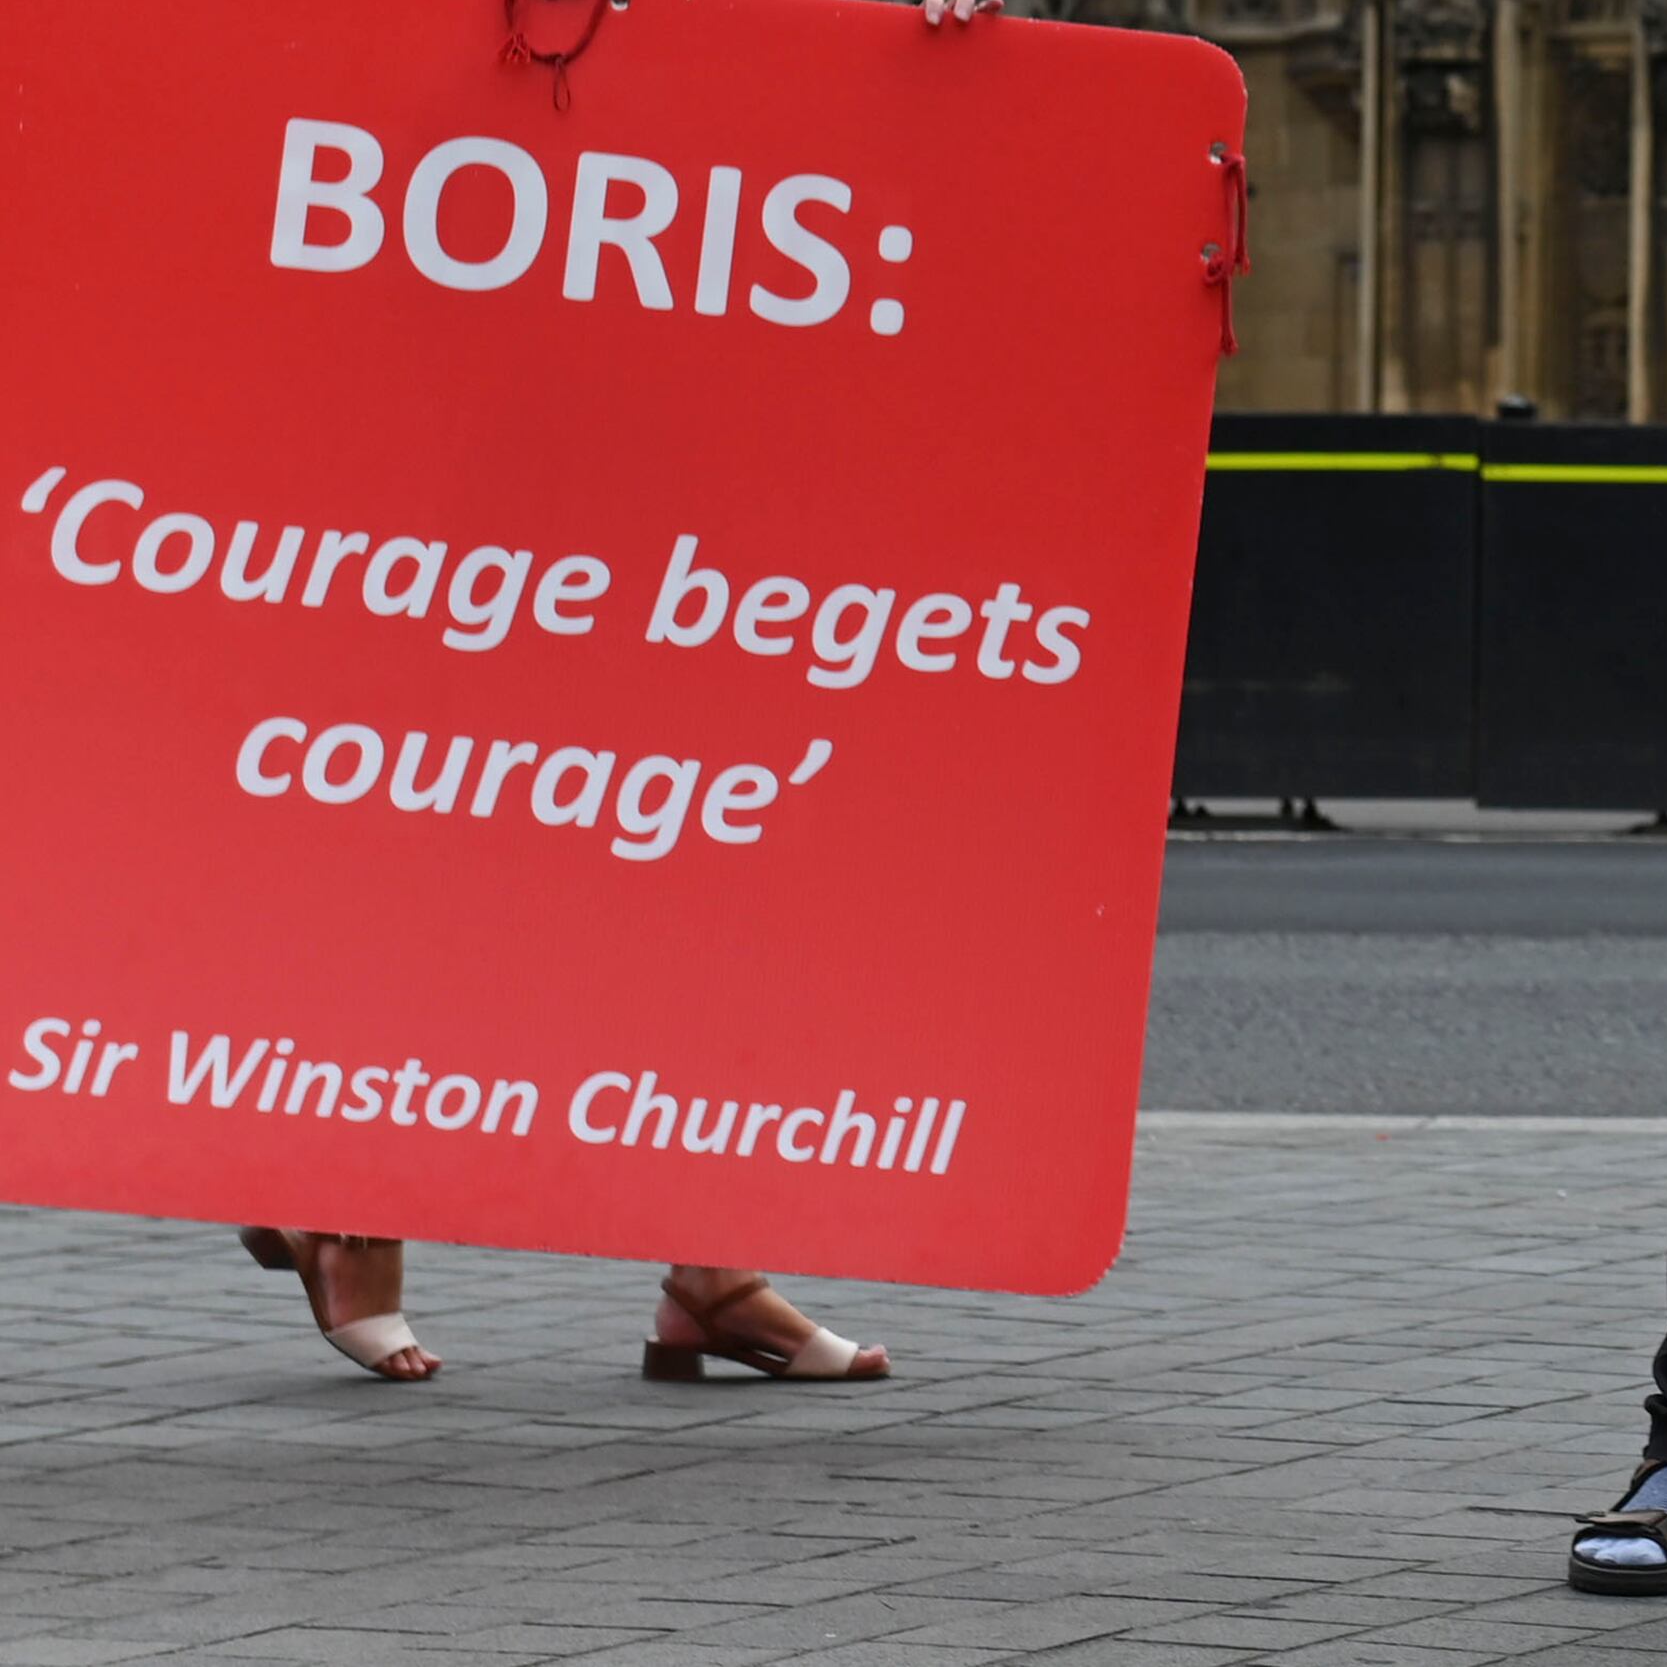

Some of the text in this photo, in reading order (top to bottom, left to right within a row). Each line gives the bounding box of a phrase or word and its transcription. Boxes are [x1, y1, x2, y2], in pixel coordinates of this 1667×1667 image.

[270, 118, 913, 335] BORIS:
[20, 467, 1091, 689] ‘Courage begets
[235, 715, 833, 862] courage’
[7, 1017, 967, 1176] Sir Winston Churchill
